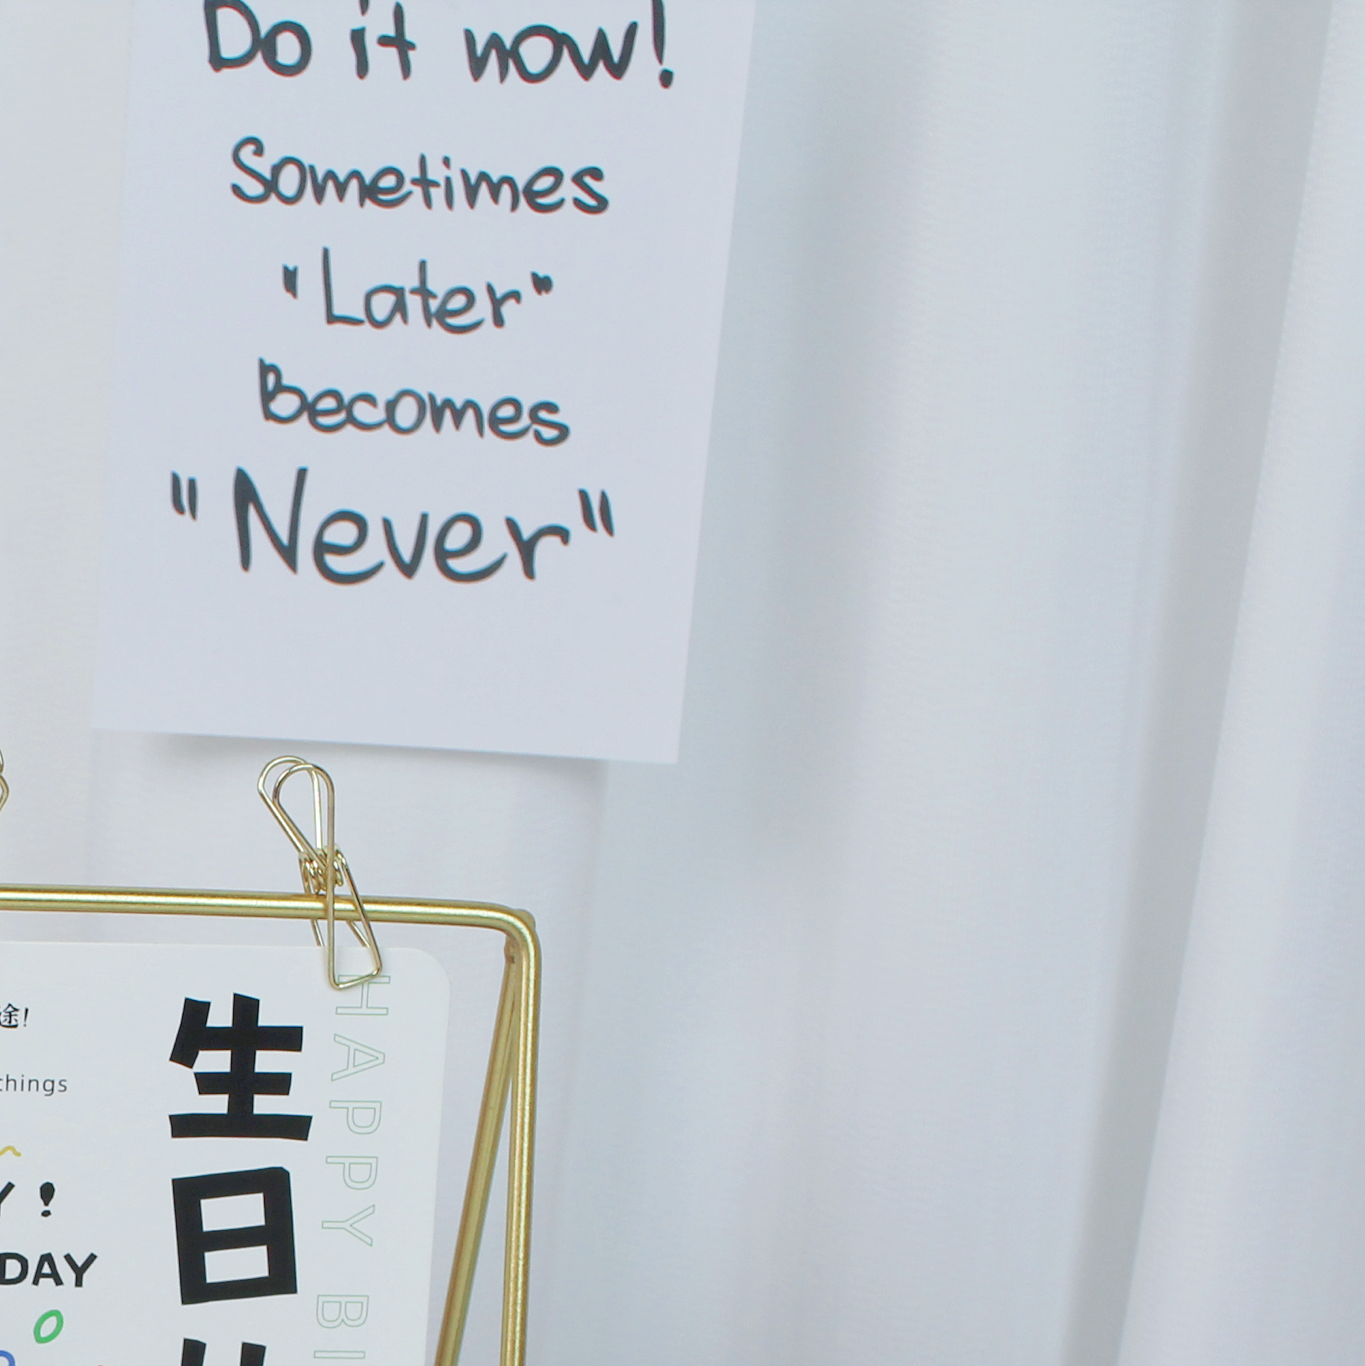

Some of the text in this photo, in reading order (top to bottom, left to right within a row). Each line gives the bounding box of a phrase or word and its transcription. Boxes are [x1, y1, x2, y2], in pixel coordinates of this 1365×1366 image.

[204, 0, 674, 88] Do it now!
[231, 136, 609, 214] Sometimes
[171, 467, 614, 585] "Never"
[321, 974, 392, 1248] HAPPY
